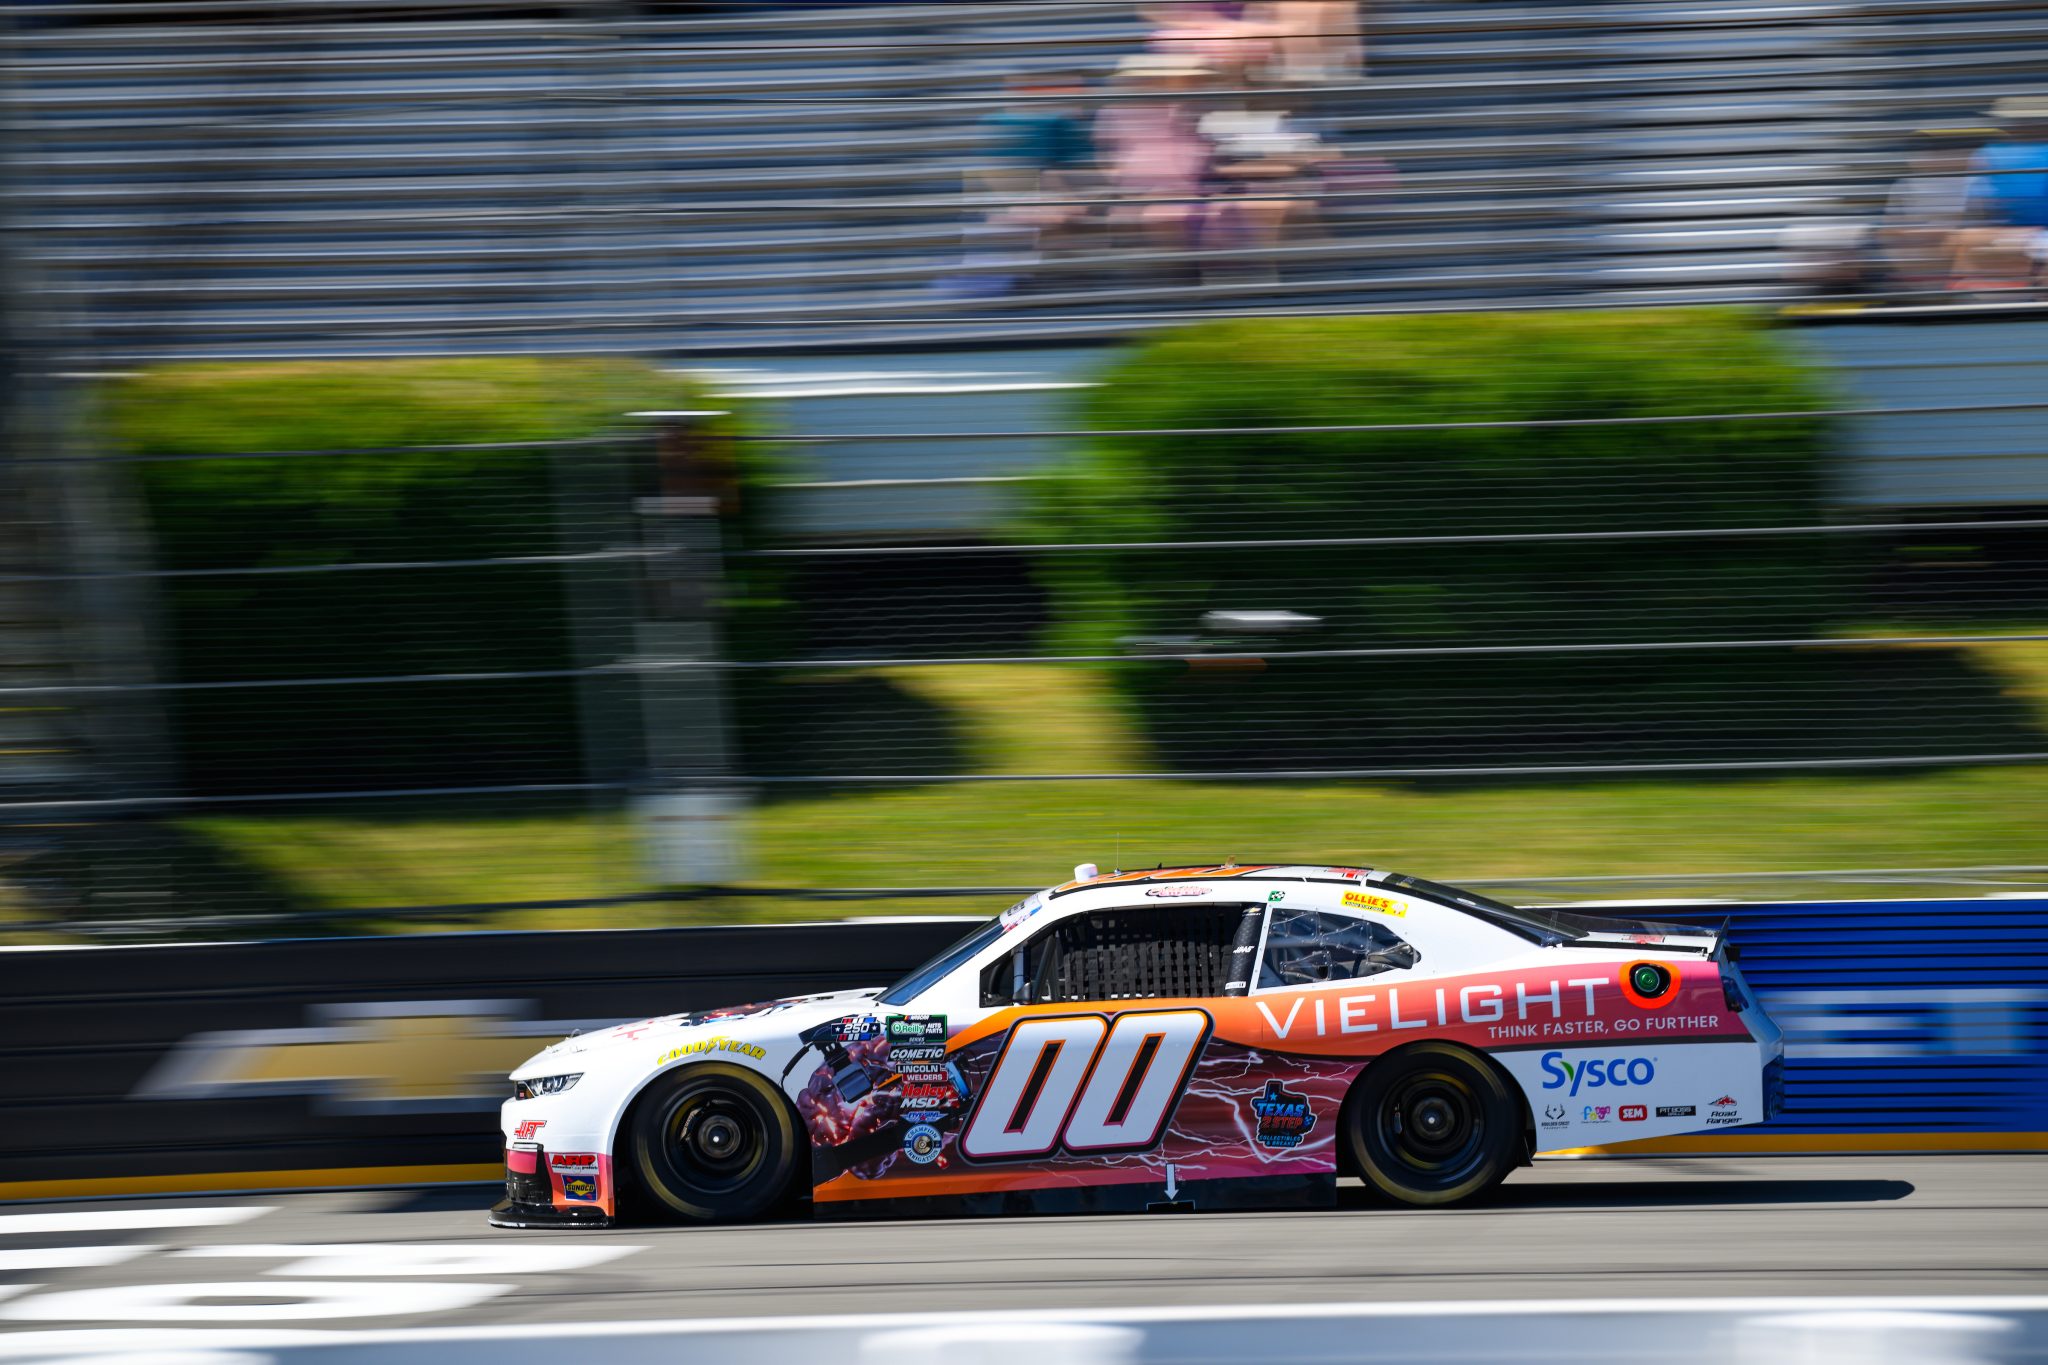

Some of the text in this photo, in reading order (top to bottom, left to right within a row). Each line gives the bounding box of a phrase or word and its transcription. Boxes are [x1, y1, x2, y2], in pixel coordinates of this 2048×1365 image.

[1256, 977, 1610, 1039] VIELIGHT
[843, 1023, 869, 1033] 250
[1488, 1015, 1719, 1039] THINK FASTER, GO FURTHER
[657, 1036, 766, 1065] GOODYEAR
[890, 1047, 945, 1059] COMETIC
[897, 1065, 939, 1073] LINCOLN
[1541, 1051, 1655, 1097] Sysco
[901, 1084, 948, 1100] Holley
[957, 1007, 1216, 1166] 00
[900, 1098, 941, 1109] MSD
[1257, 1103, 1304, 1116] TEXAS
[1623, 1108, 1644, 1119] SEM
[1273, 1117, 1303, 1128] STEP
[908, 1126, 938, 1139] CHAMPION
[551, 1154, 597, 1166] ARP
[906, 1149, 940, 1163] IRRIGATION
[565, 1183, 595, 1193] SUNOCO
